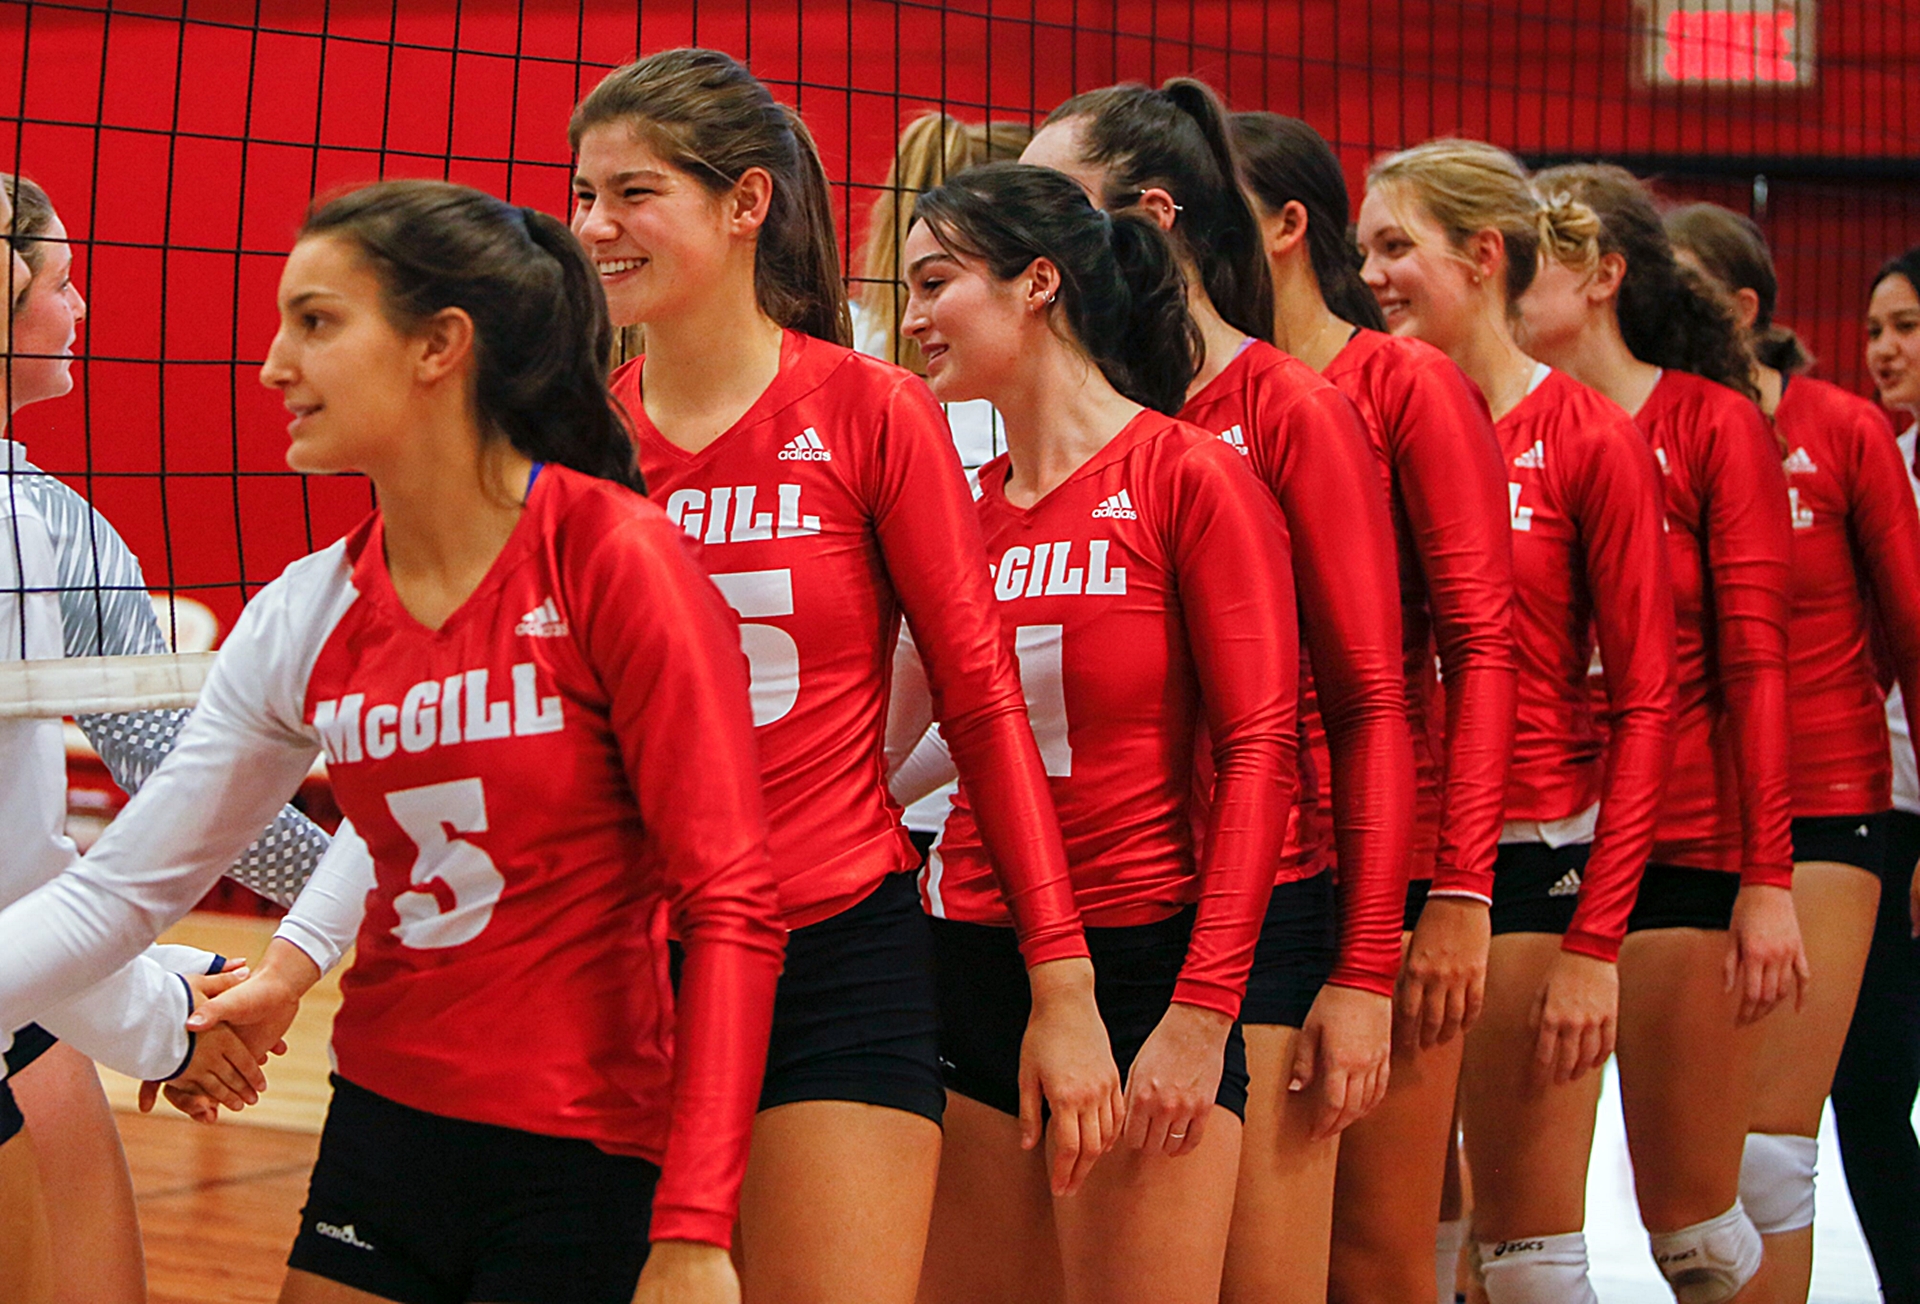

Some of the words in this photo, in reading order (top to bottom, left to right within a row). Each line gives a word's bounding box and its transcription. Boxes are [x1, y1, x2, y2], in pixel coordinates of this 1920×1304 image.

[777, 448, 832, 462] adidas
[666, 484, 821, 545] GILL
[1091, 507, 1138, 520] adidas
[989, 540, 1127, 602] GILL
[313, 662, 564, 765] McGILL
[384, 777, 506, 950] 5
